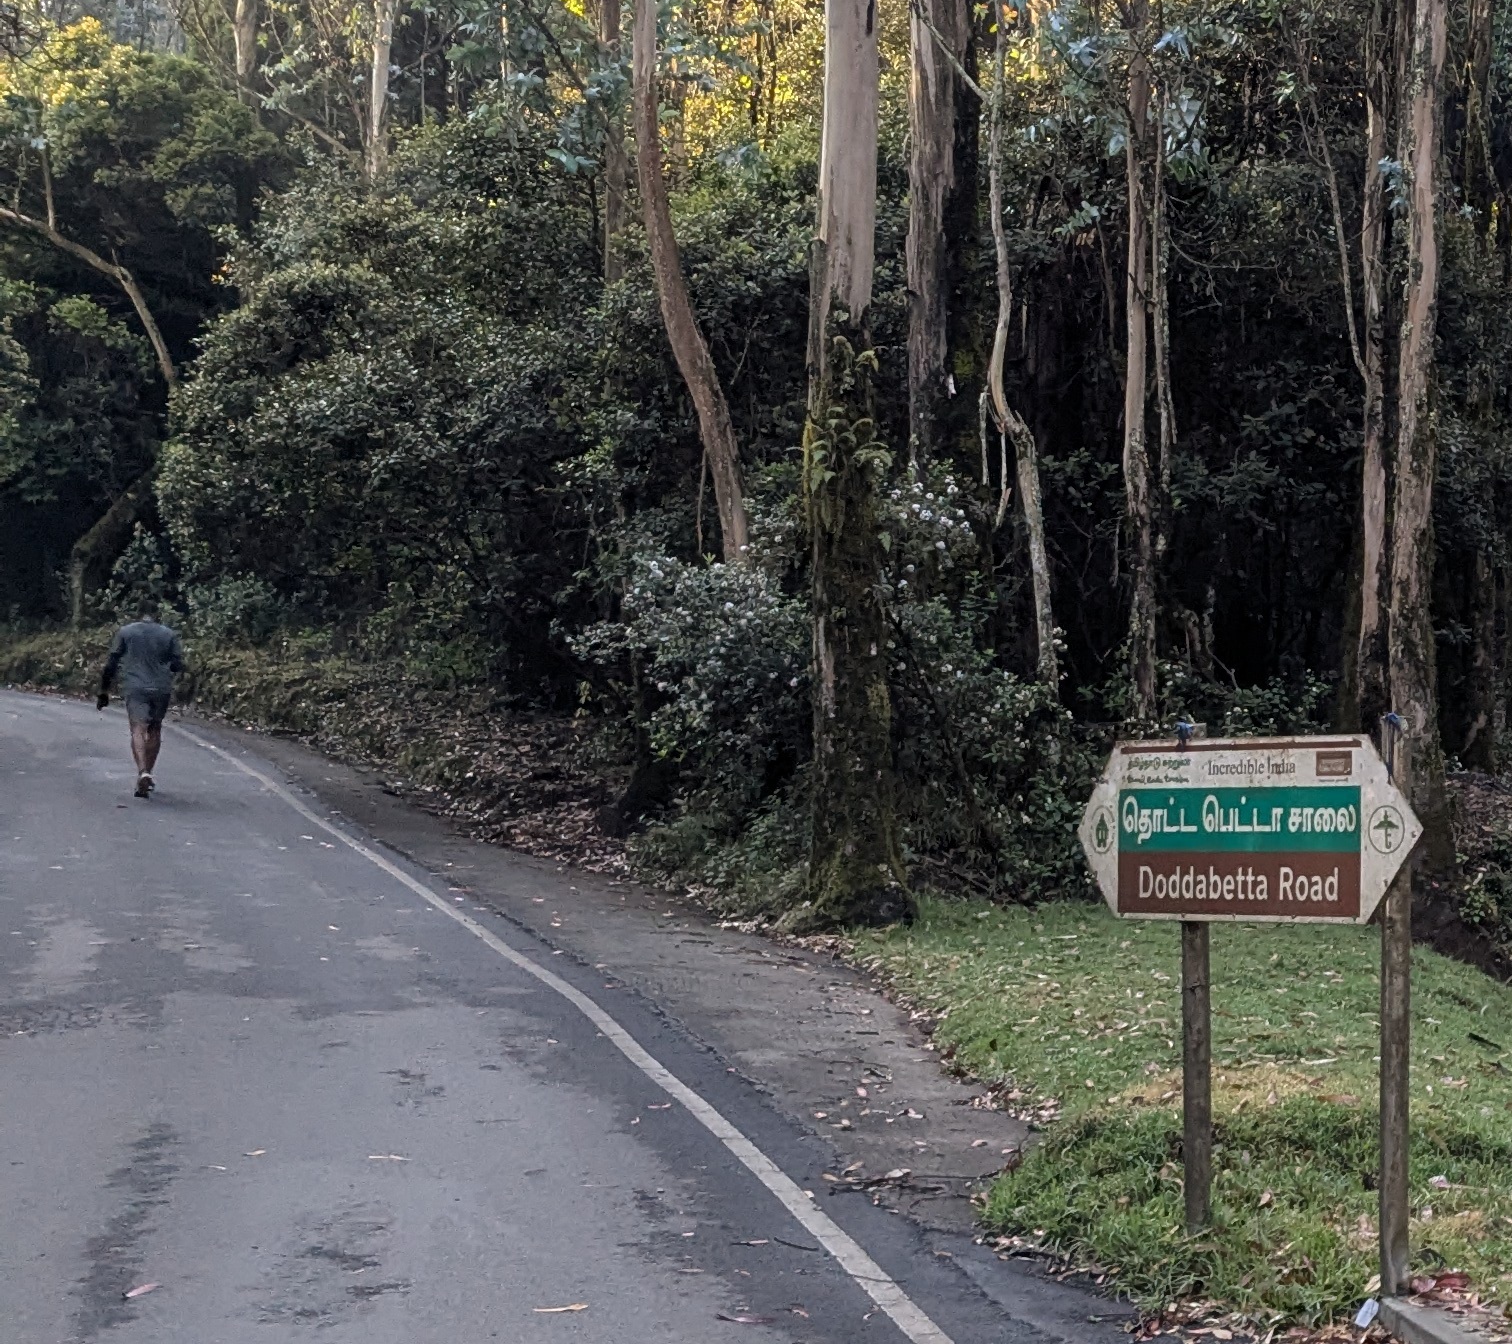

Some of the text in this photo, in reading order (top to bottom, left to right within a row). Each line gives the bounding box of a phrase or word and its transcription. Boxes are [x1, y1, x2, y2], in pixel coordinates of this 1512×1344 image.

[1208, 759, 1265, 775] Incredible
[1122, 794, 1356, 845] தொட்ட பெட்டா சாலை
[1139, 865, 1339, 902] Doddabetta Road
